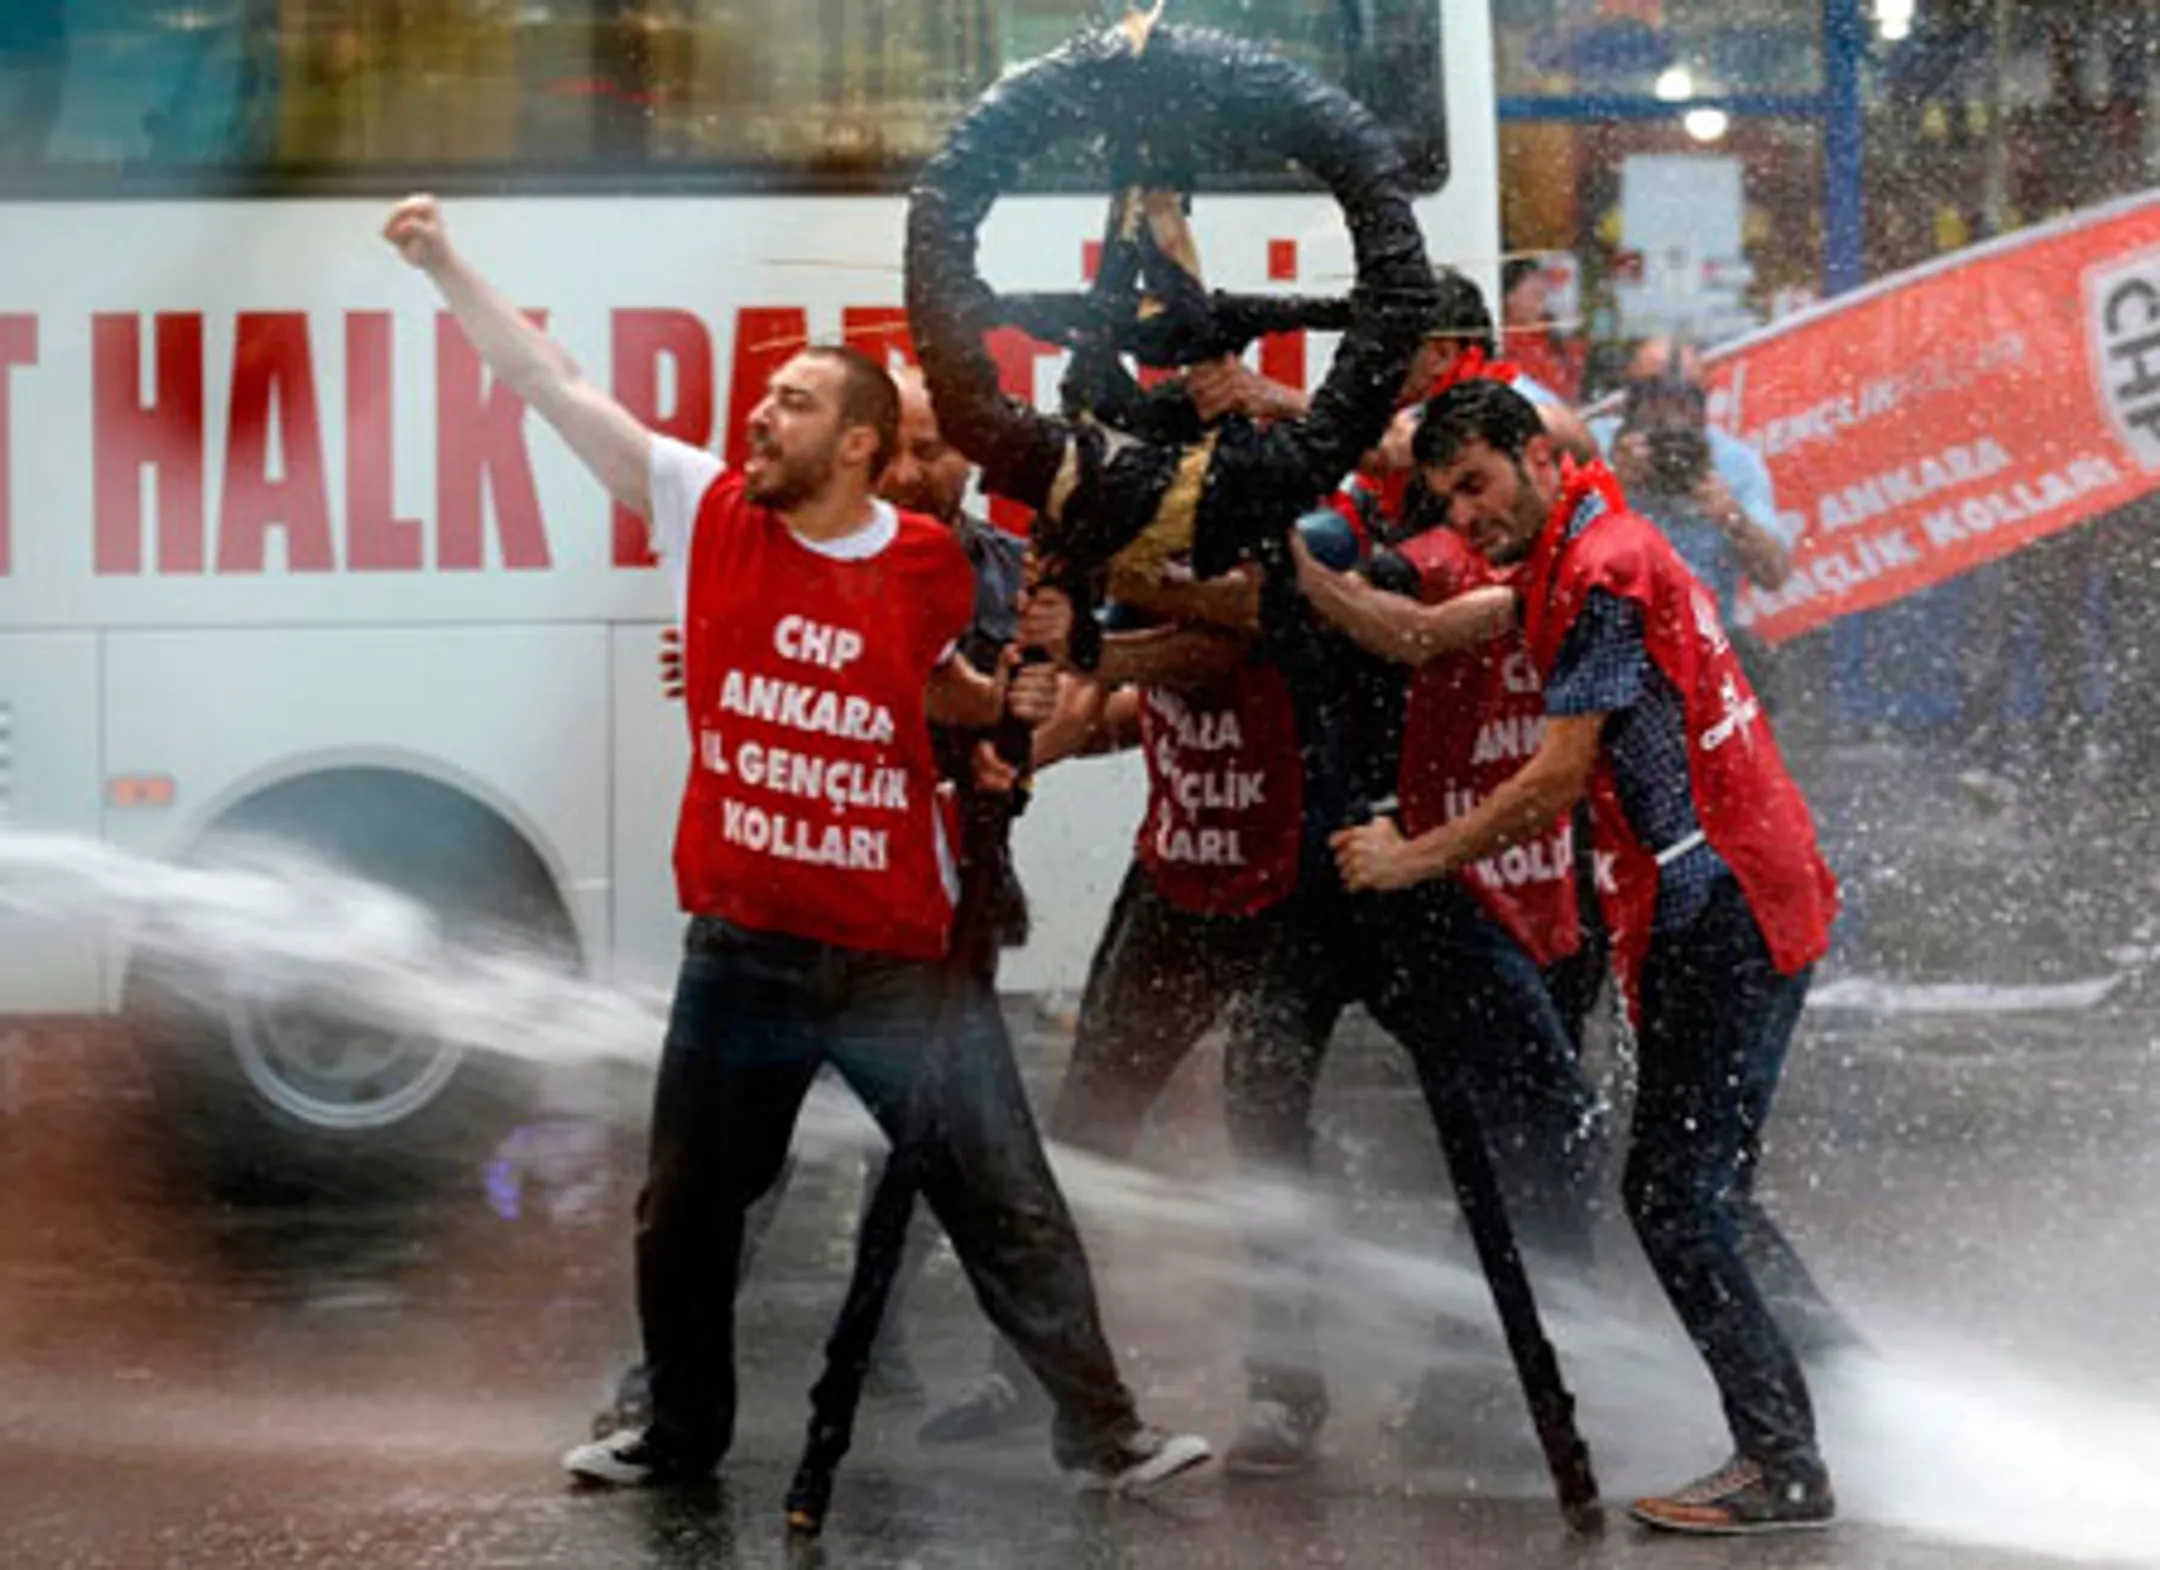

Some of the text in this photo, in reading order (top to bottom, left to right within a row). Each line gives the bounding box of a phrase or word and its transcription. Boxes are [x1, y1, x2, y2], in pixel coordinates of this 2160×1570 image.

[91, 308, 553, 577] HALK
[1818, 437, 2012, 532] ANKARA
[1921, 455, 2120, 551] KOLLARI
[773, 614, 864, 671] CHP
[719, 669, 895, 745] ANKARA
[736, 740, 909, 816] GENÇLİK
[721, 797, 889, 872] KOLLARI
